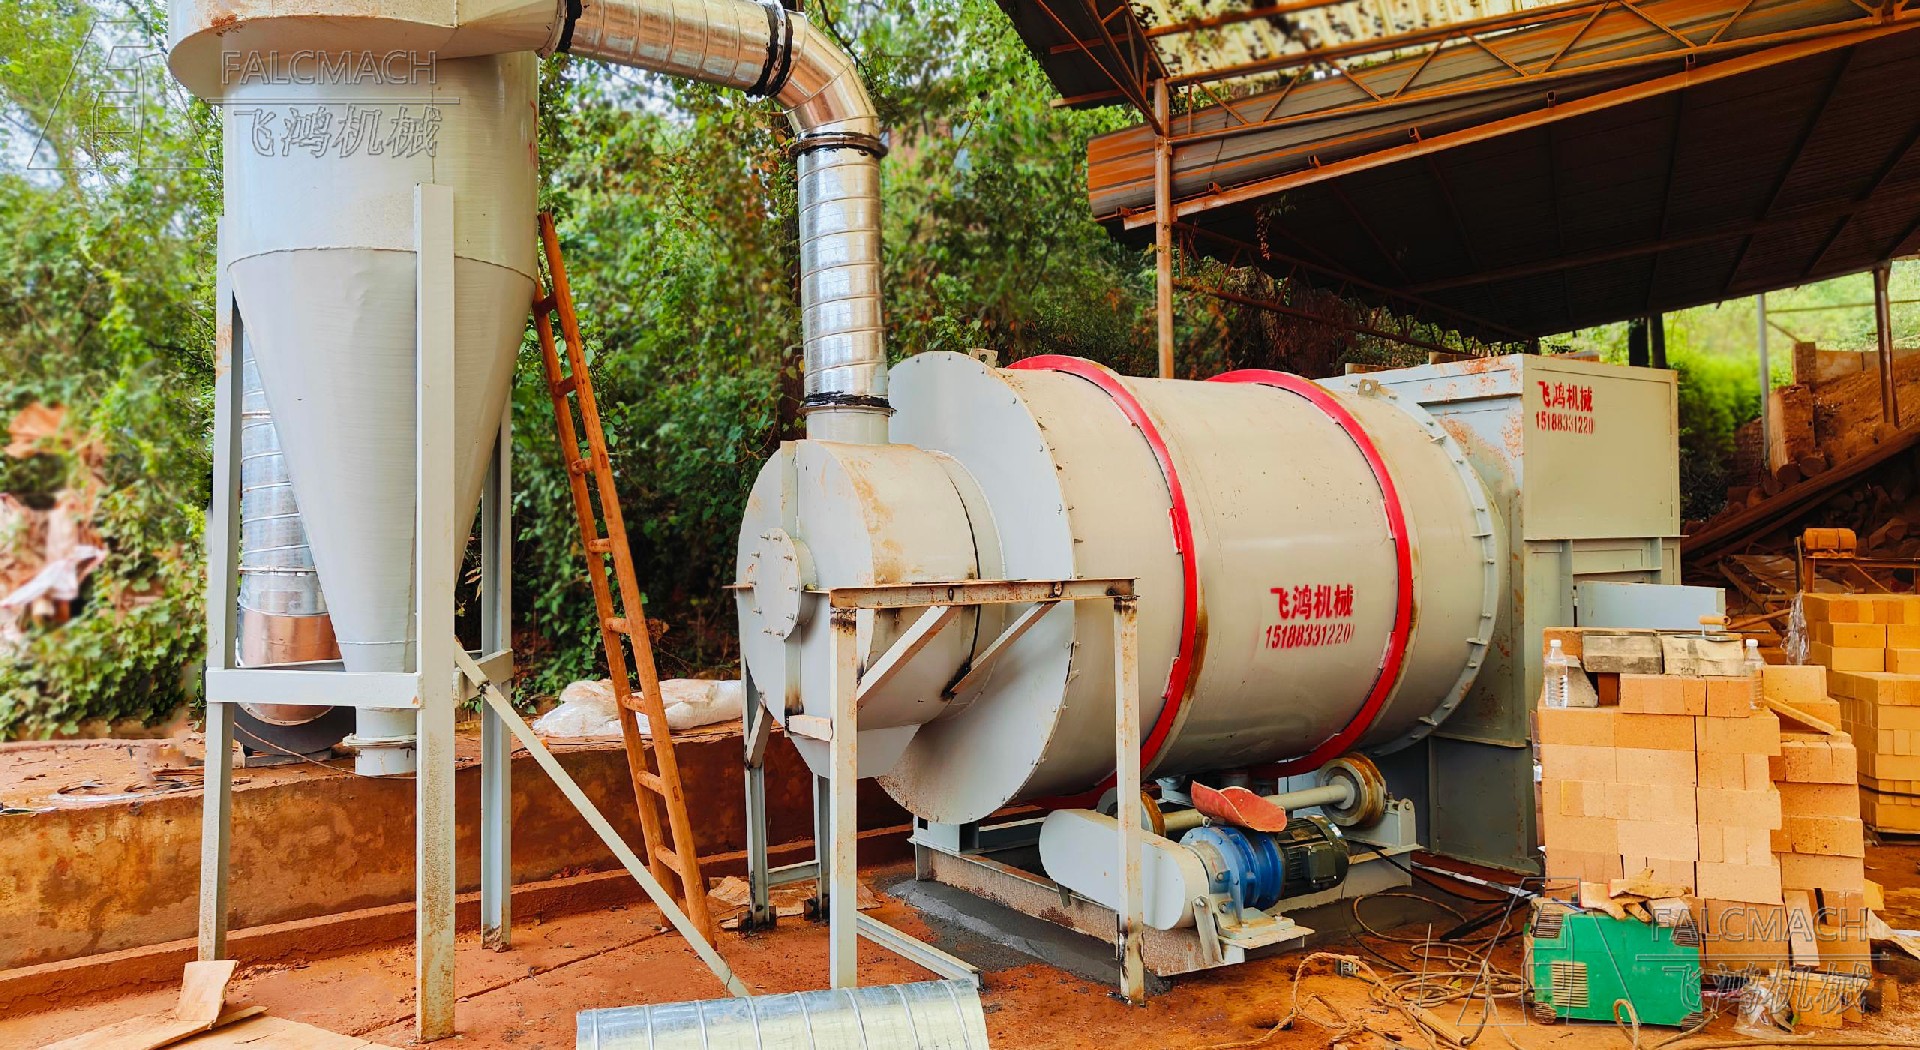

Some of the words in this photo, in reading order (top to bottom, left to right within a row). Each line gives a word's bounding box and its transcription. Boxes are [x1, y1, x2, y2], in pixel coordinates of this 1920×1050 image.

[1537, 381, 1593, 412] 飞鸿机械
[1270, 584, 1354, 620] 飞鸿机械
